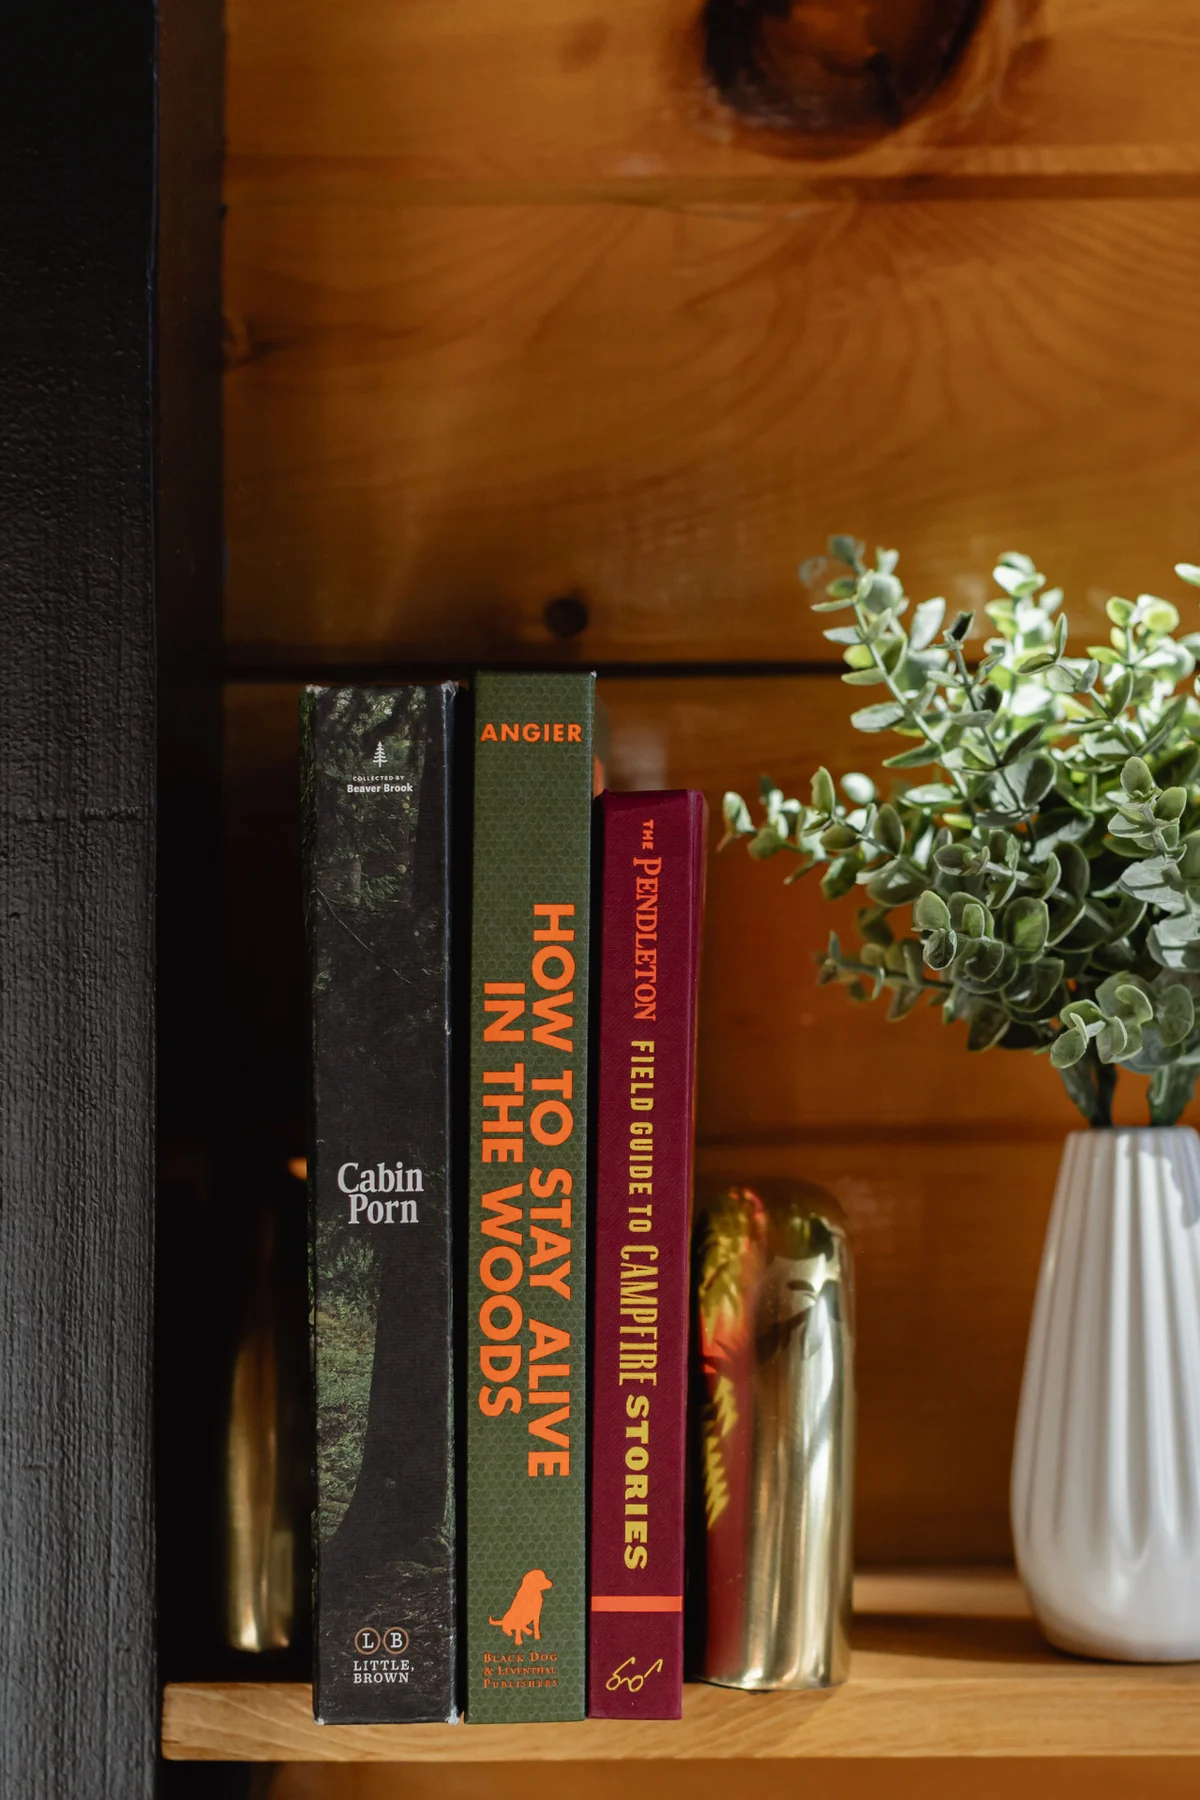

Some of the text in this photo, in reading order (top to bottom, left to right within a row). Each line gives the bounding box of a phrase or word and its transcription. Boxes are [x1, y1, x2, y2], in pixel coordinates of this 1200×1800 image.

[480, 723, 583, 743] ANGIER
[346, 783, 414, 793] Beaver Brook
[337, 1161, 425, 1194] Cabin
[527, 903, 575, 1477] HOW TO STAY ALIVE
[478, 982, 526, 1417] IN THE WOODS
[618, 819, 662, 1570] THE PENDLETON FIELD GUIDE TO CAMPFIRE STORIES
[348, 1193, 419, 1225] Porn
[353, 1659, 415, 1672] LITTLE,
[353, 1671, 410, 1684] BROWN
[483, 1666, 494, 1676] &
